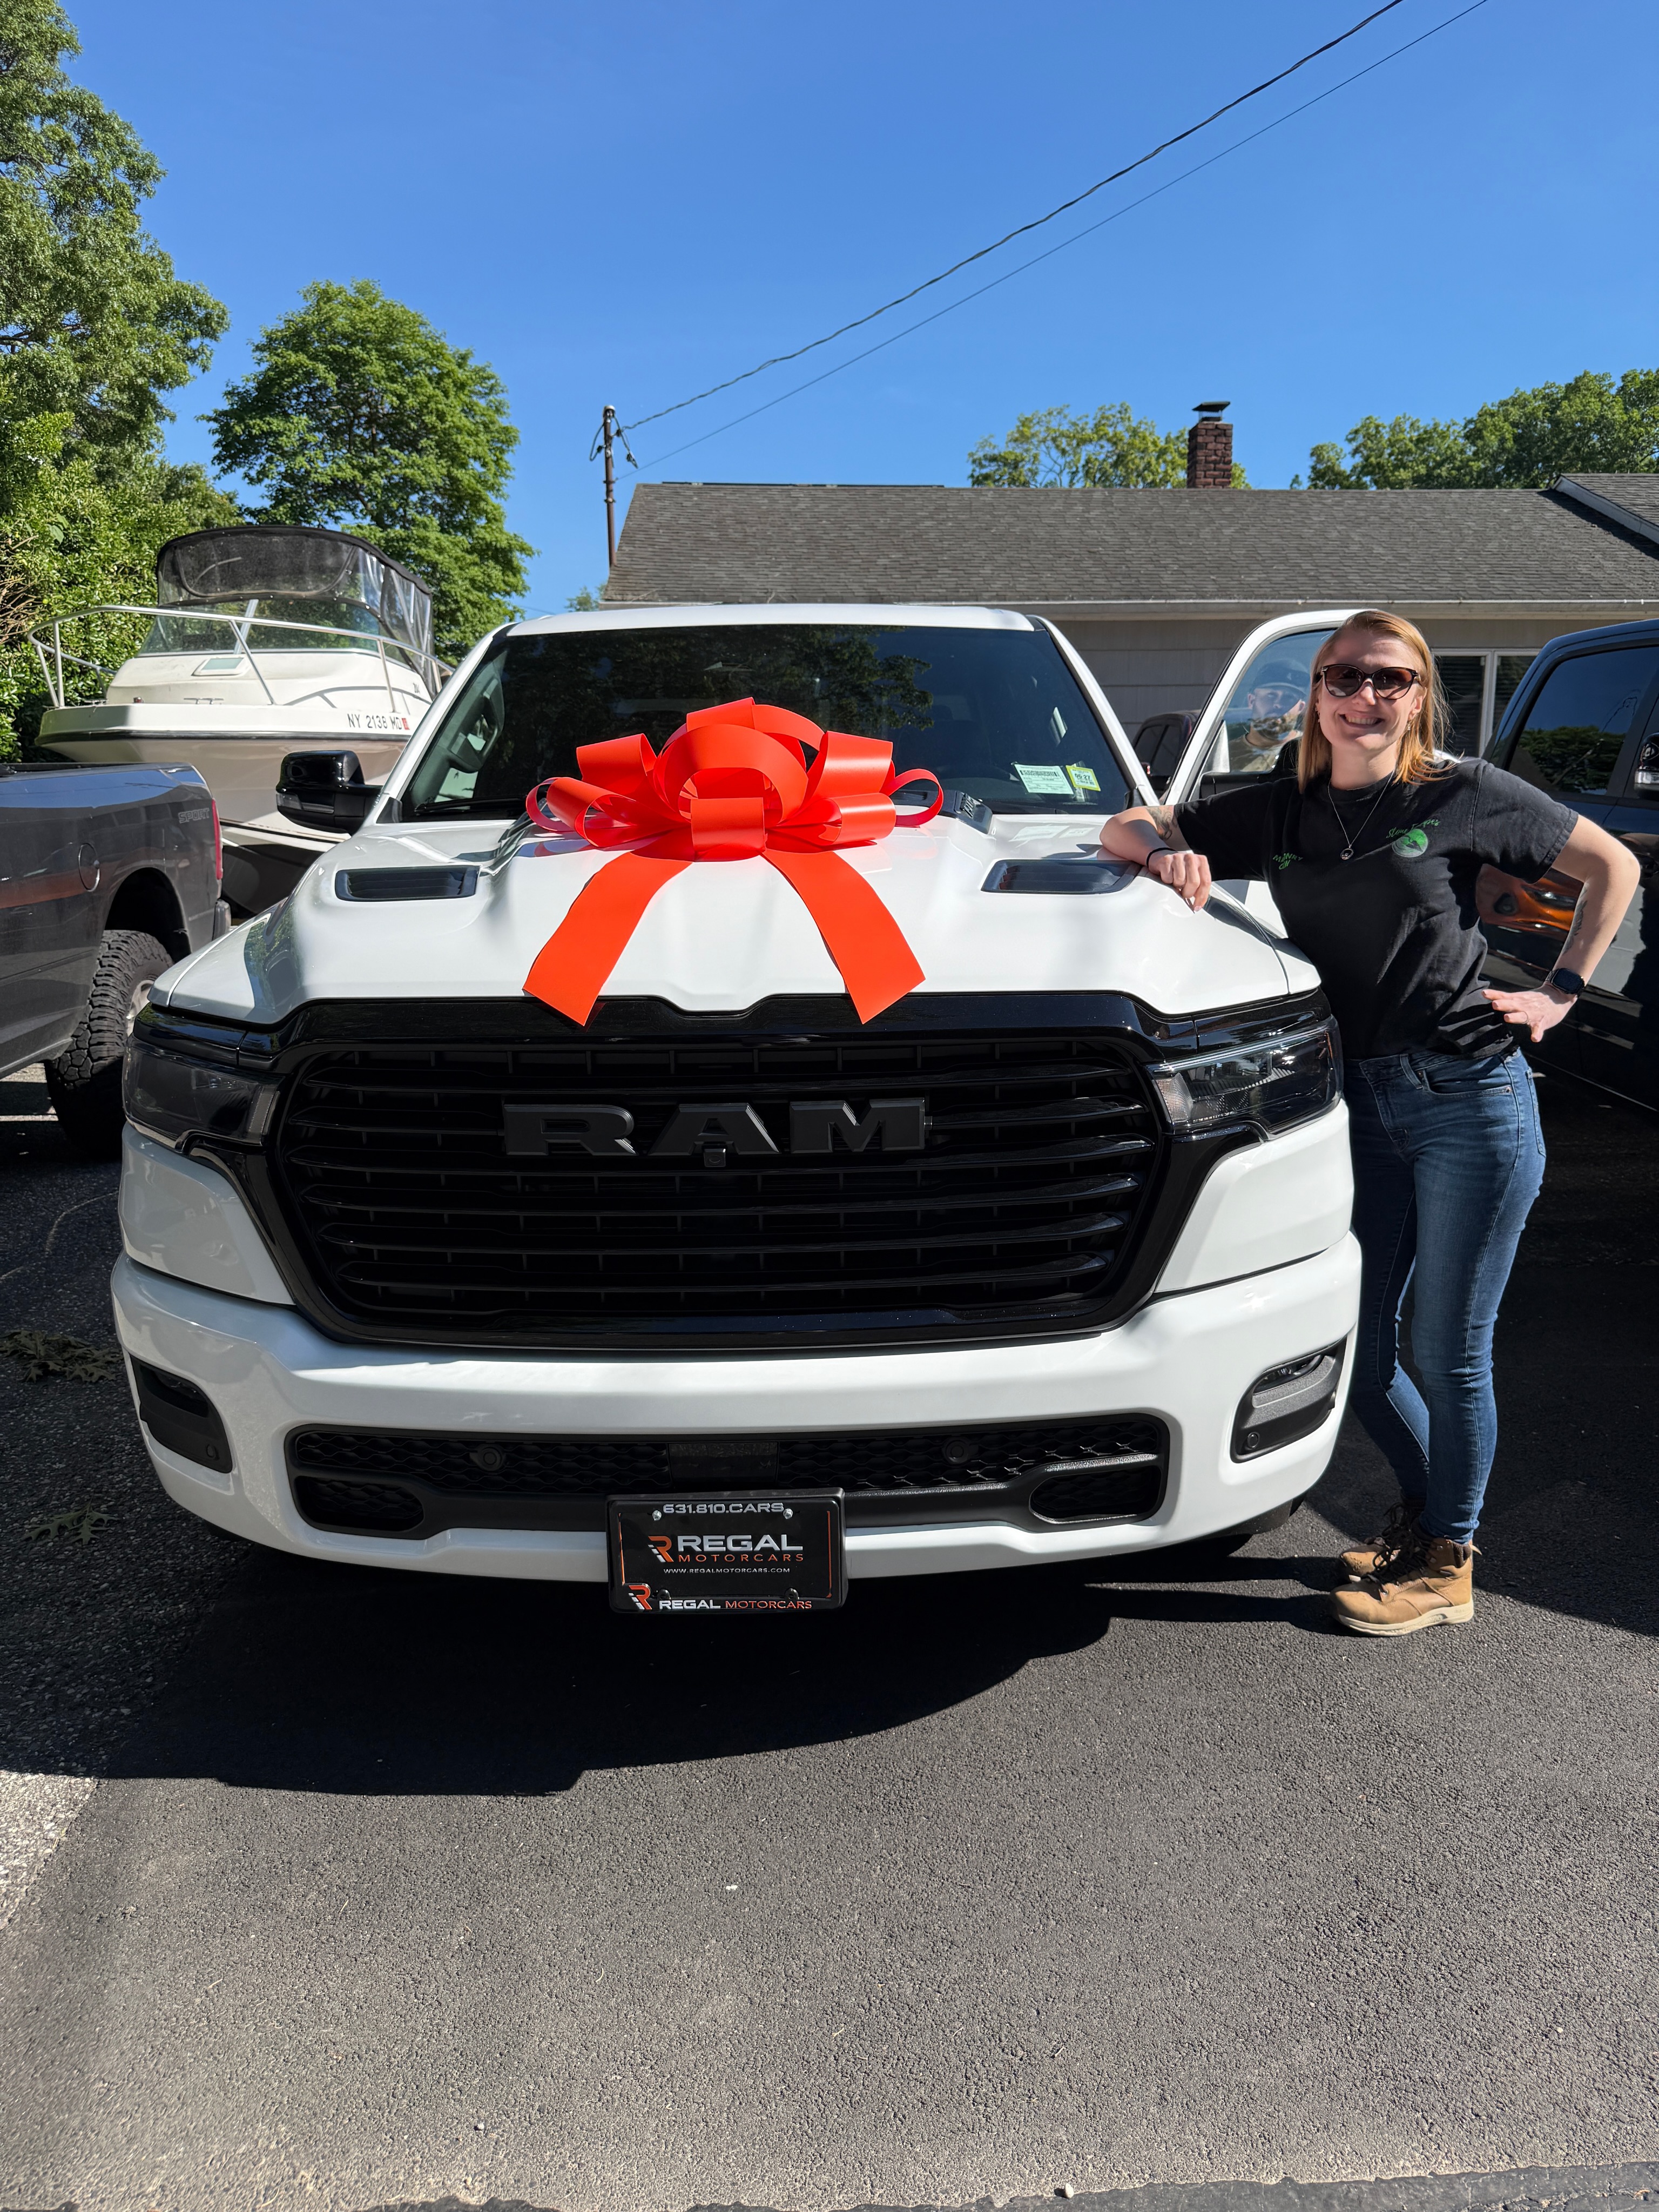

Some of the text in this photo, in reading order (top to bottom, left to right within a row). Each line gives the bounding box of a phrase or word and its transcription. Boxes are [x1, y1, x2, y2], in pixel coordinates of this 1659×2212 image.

[347, 713, 360, 728] NY
[366, 715, 388, 729] 2138
[390, 716, 402, 730] MD
[178, 808, 210, 824] SPORT
[503, 1098, 926, 1156] RAM
[663, 1502, 784, 1513] 631.810.CARS
[677, 1534, 803, 1552] REGAL
[678, 1554, 804, 1562] MOTORCARS
[659, 1599, 721, 1609] REGAL
[725, 1601, 812, 1609] MOTORCARS
